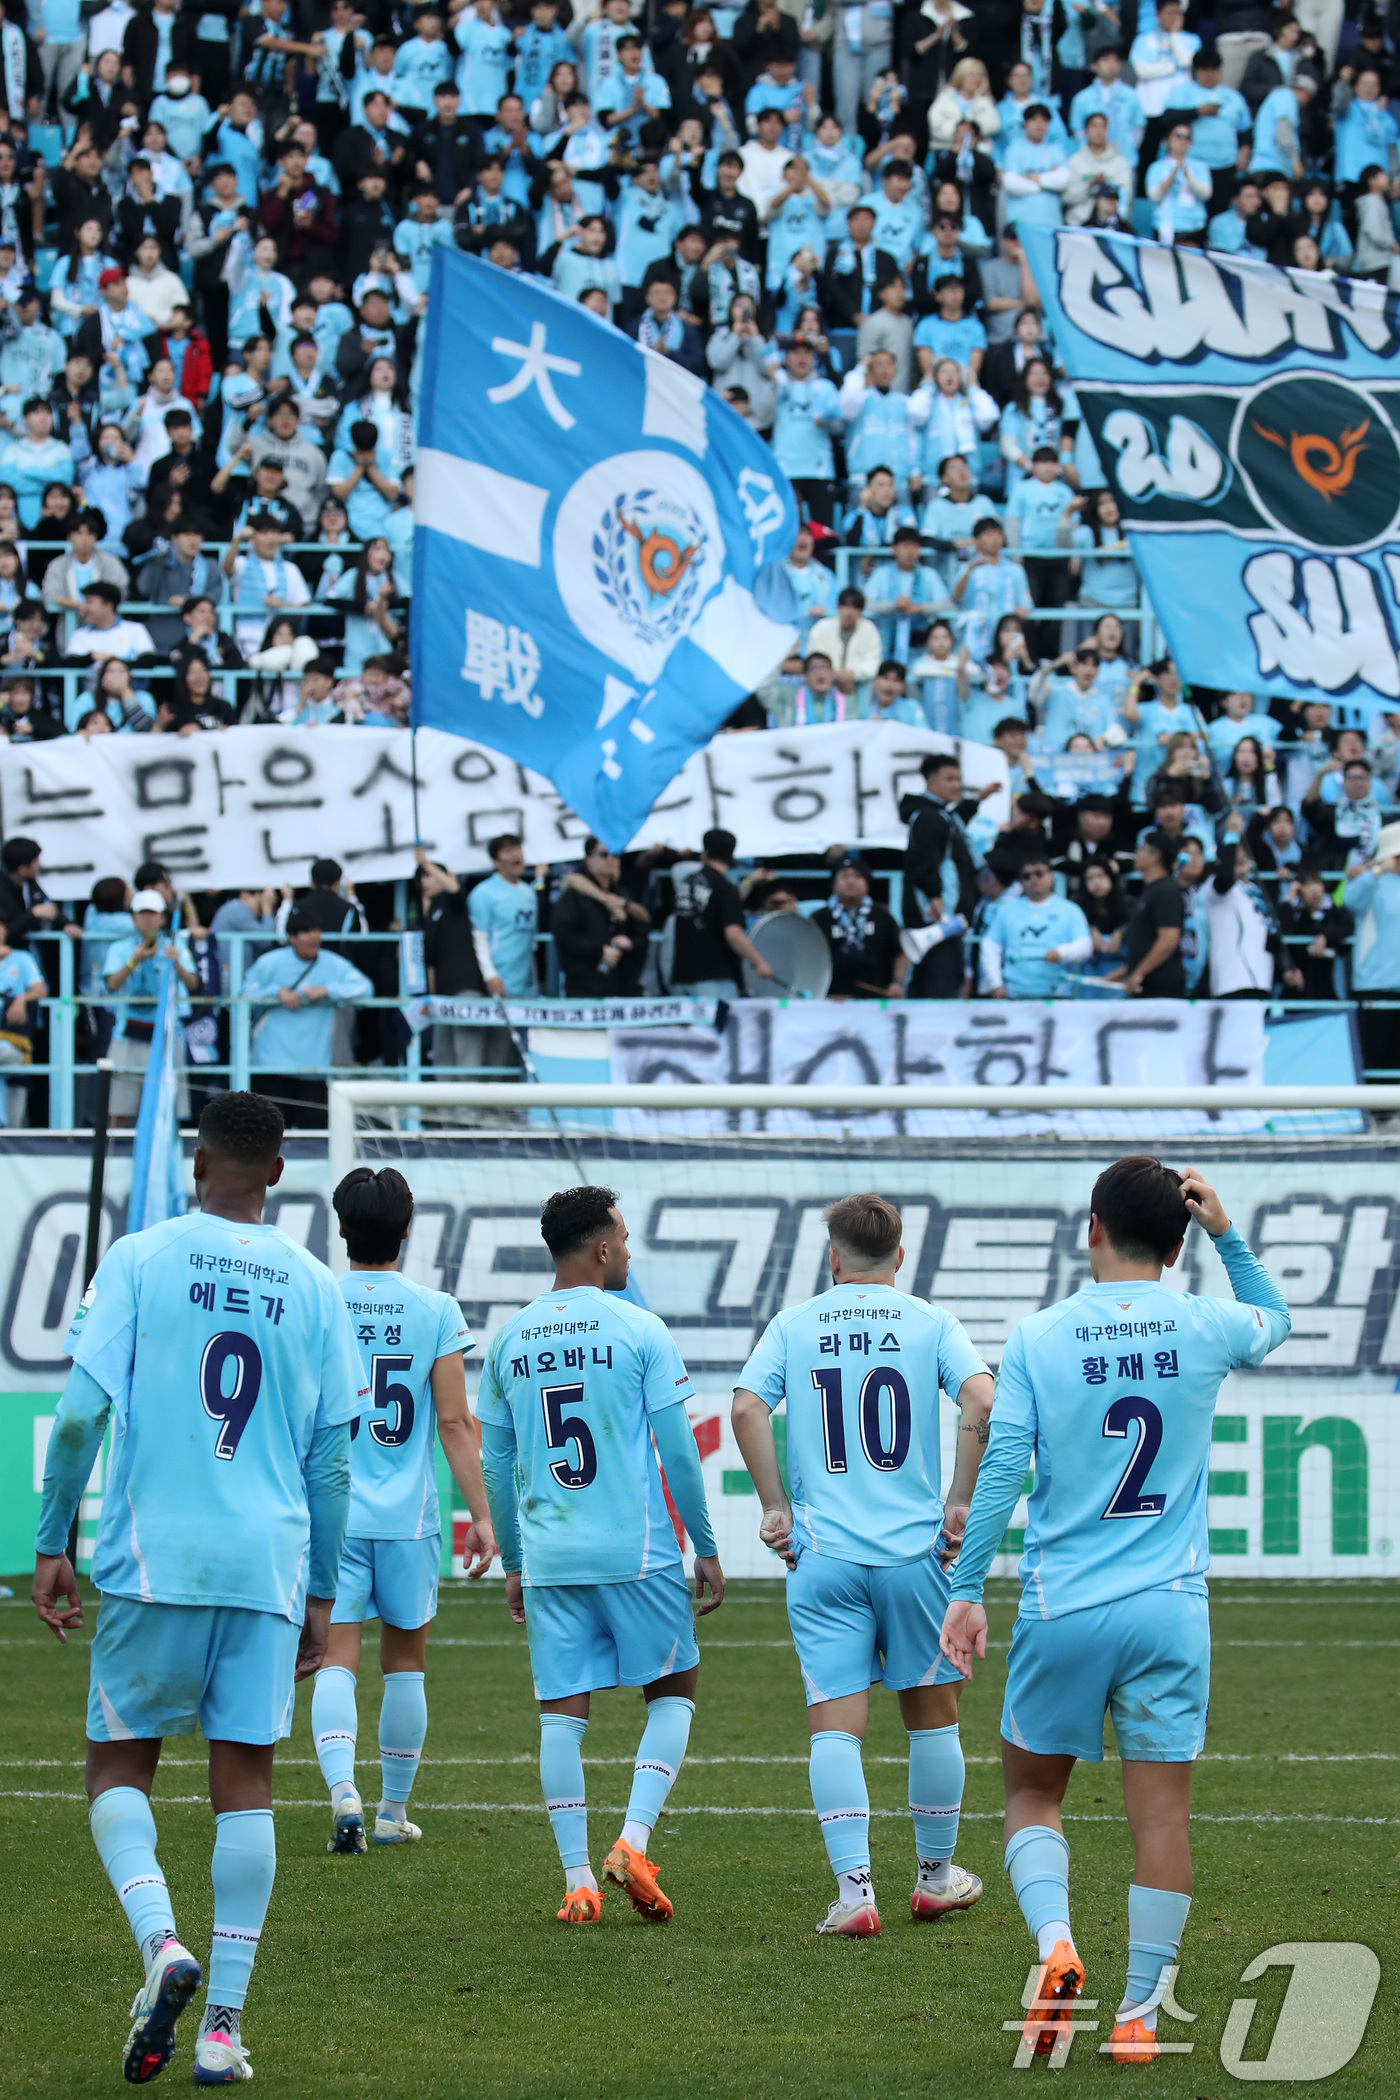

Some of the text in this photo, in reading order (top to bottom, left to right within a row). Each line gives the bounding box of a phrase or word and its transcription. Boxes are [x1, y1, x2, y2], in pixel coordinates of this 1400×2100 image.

[486, 321, 582, 431] 大
[461, 608, 545, 719] 戰
[189, 1253, 289, 1285] 대구한의대학교
[189, 1282, 285, 1325] 에드가
[819, 1308, 902, 1323] 대구한의대학교
[521, 1320, 599, 1341] 대구한의대학교
[819, 1332, 901, 1357] 라마스
[1076, 1320, 1177, 1342] 대구한의대학교
[510, 1346, 613, 1378] 지오바니
[1081, 1350, 1179, 1385] 황재원
[199, 1331, 262, 1461] 9
[541, 1382, 598, 1490] 5
[811, 1366, 911, 1473] 10
[1100, 1396, 1167, 1520] 2
